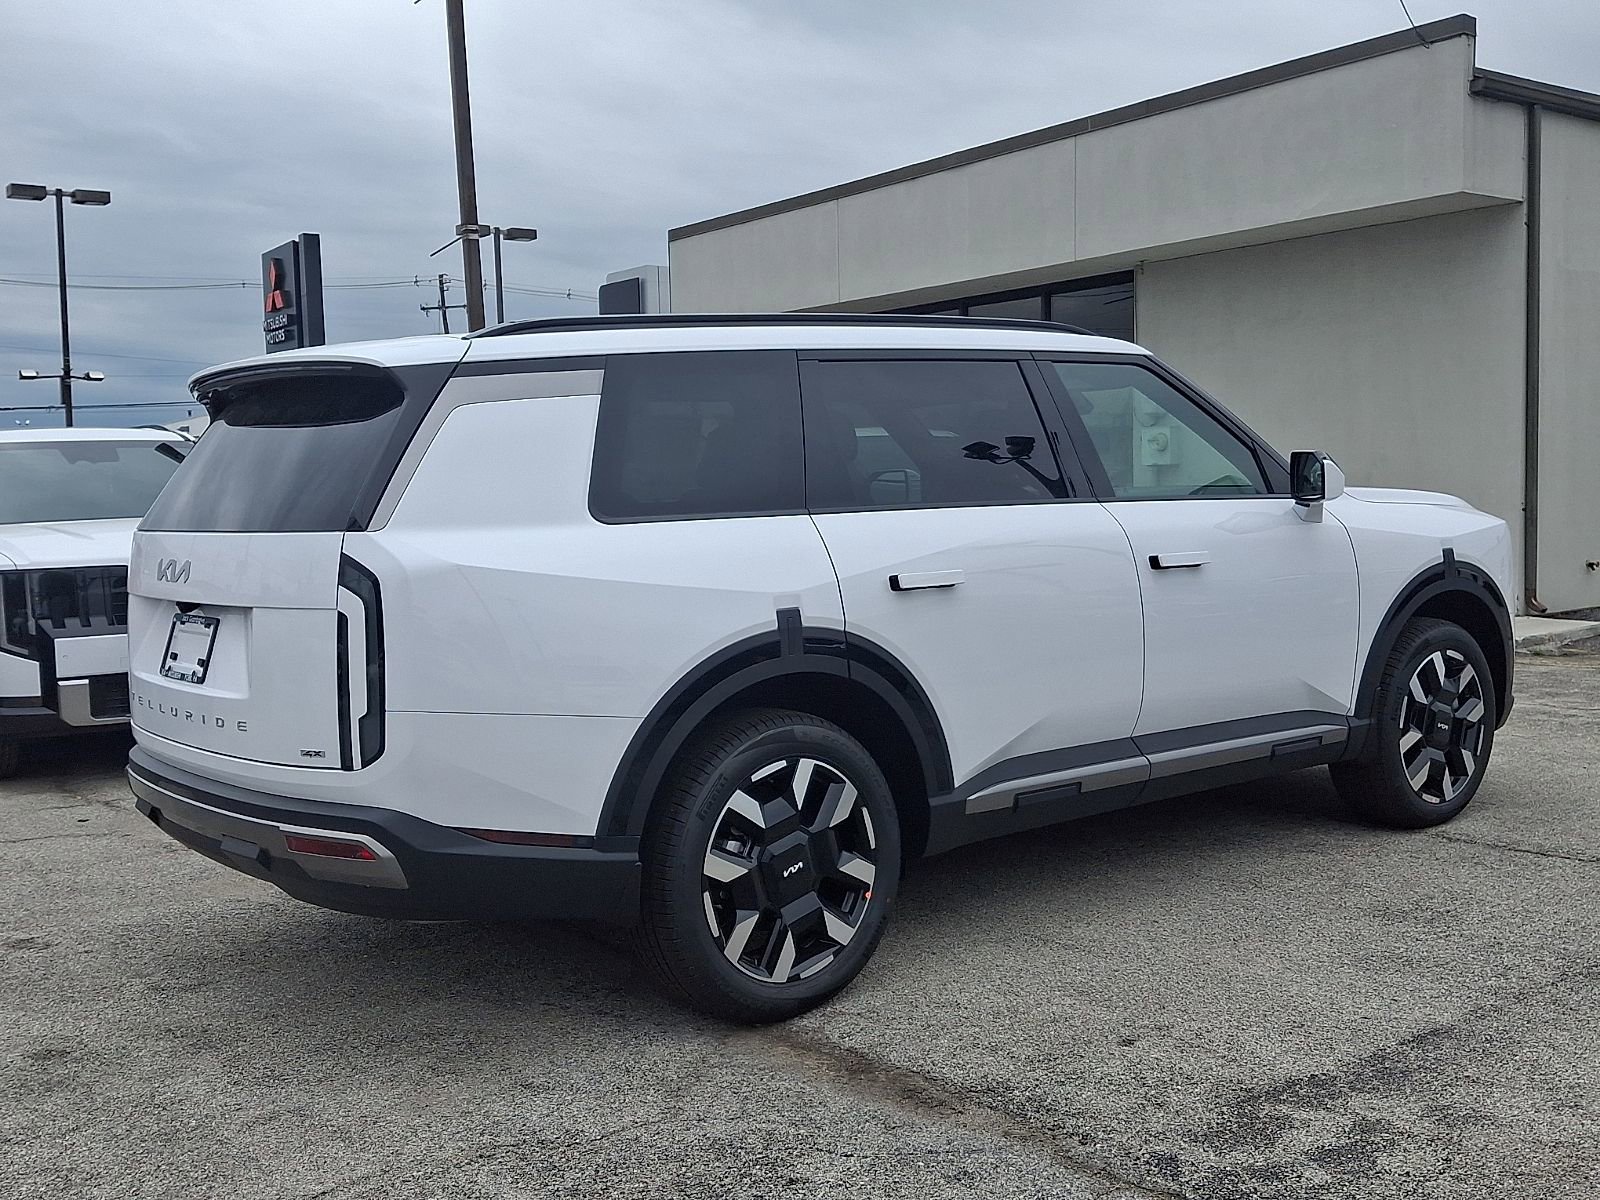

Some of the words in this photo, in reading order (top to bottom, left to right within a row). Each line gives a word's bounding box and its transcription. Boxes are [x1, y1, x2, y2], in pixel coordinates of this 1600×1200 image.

[266, 329, 285, 343] MOTORS
[157, 558, 191, 583] KIA
[131, 691, 248, 732] TELLURIDE
[783, 861, 803, 878] KIA
